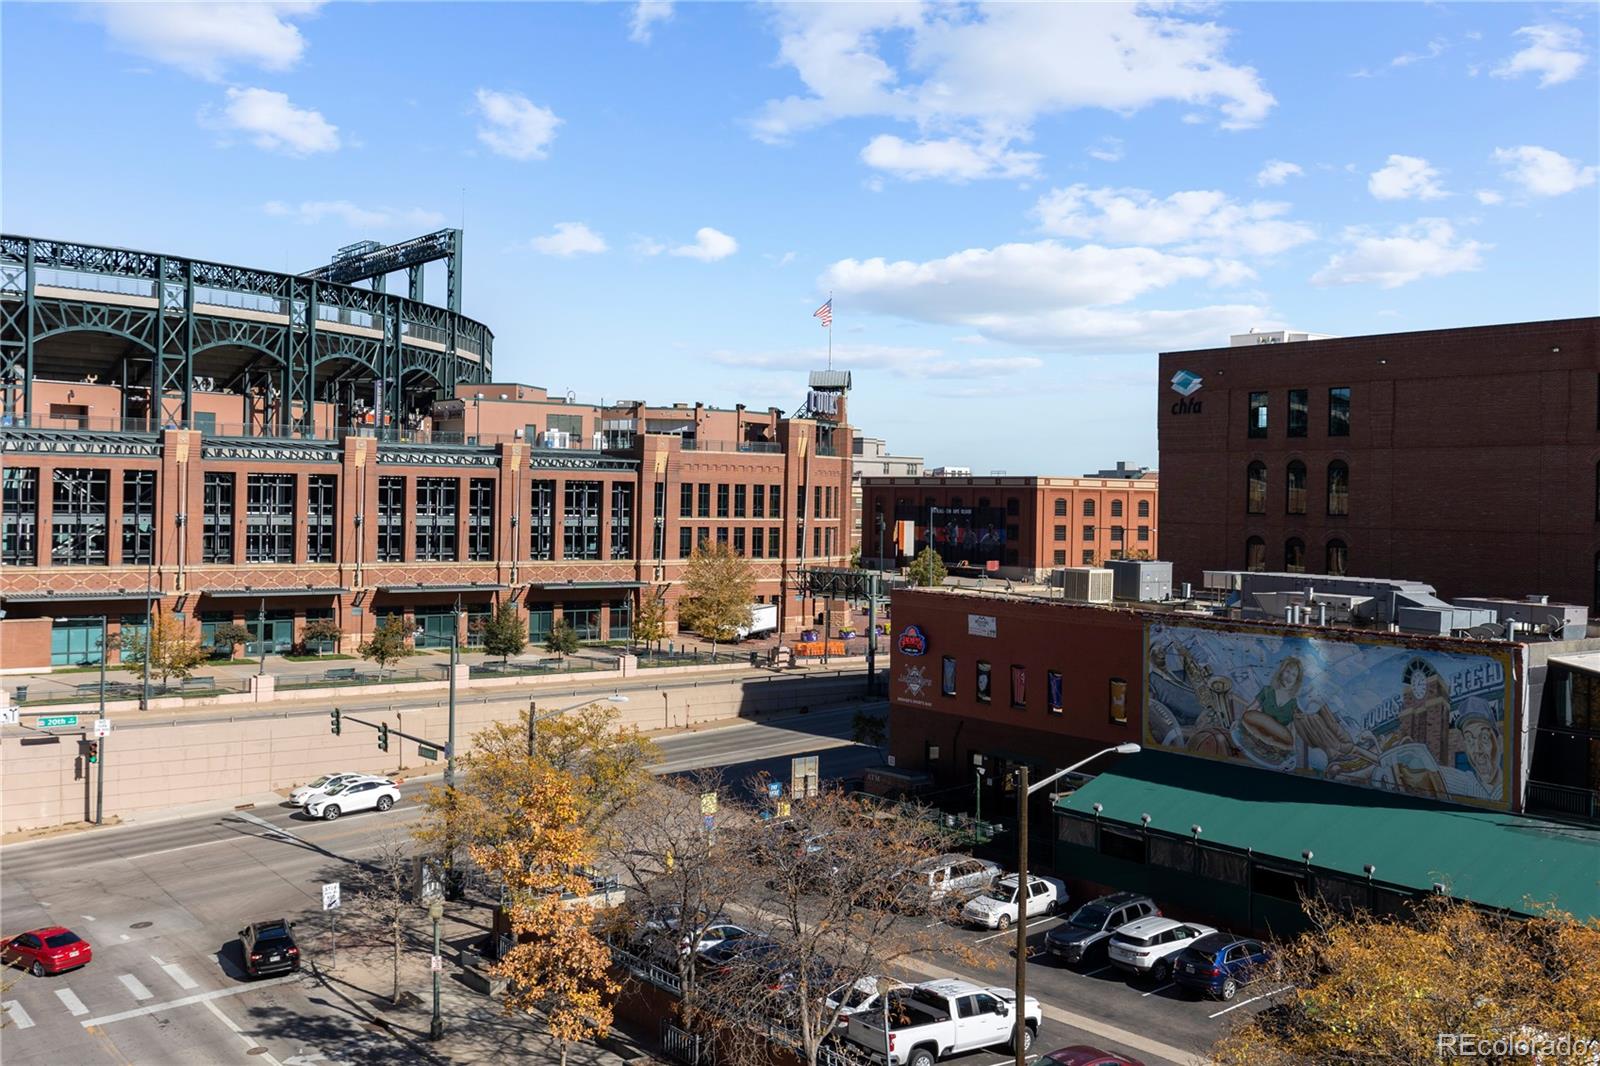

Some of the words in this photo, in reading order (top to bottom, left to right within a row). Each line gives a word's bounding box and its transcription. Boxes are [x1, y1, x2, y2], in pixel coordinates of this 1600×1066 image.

[1171, 397, 1202, 415] chfa
[1450, 662, 1504, 696] FIELD
[47, 718, 66, 726] 20th
